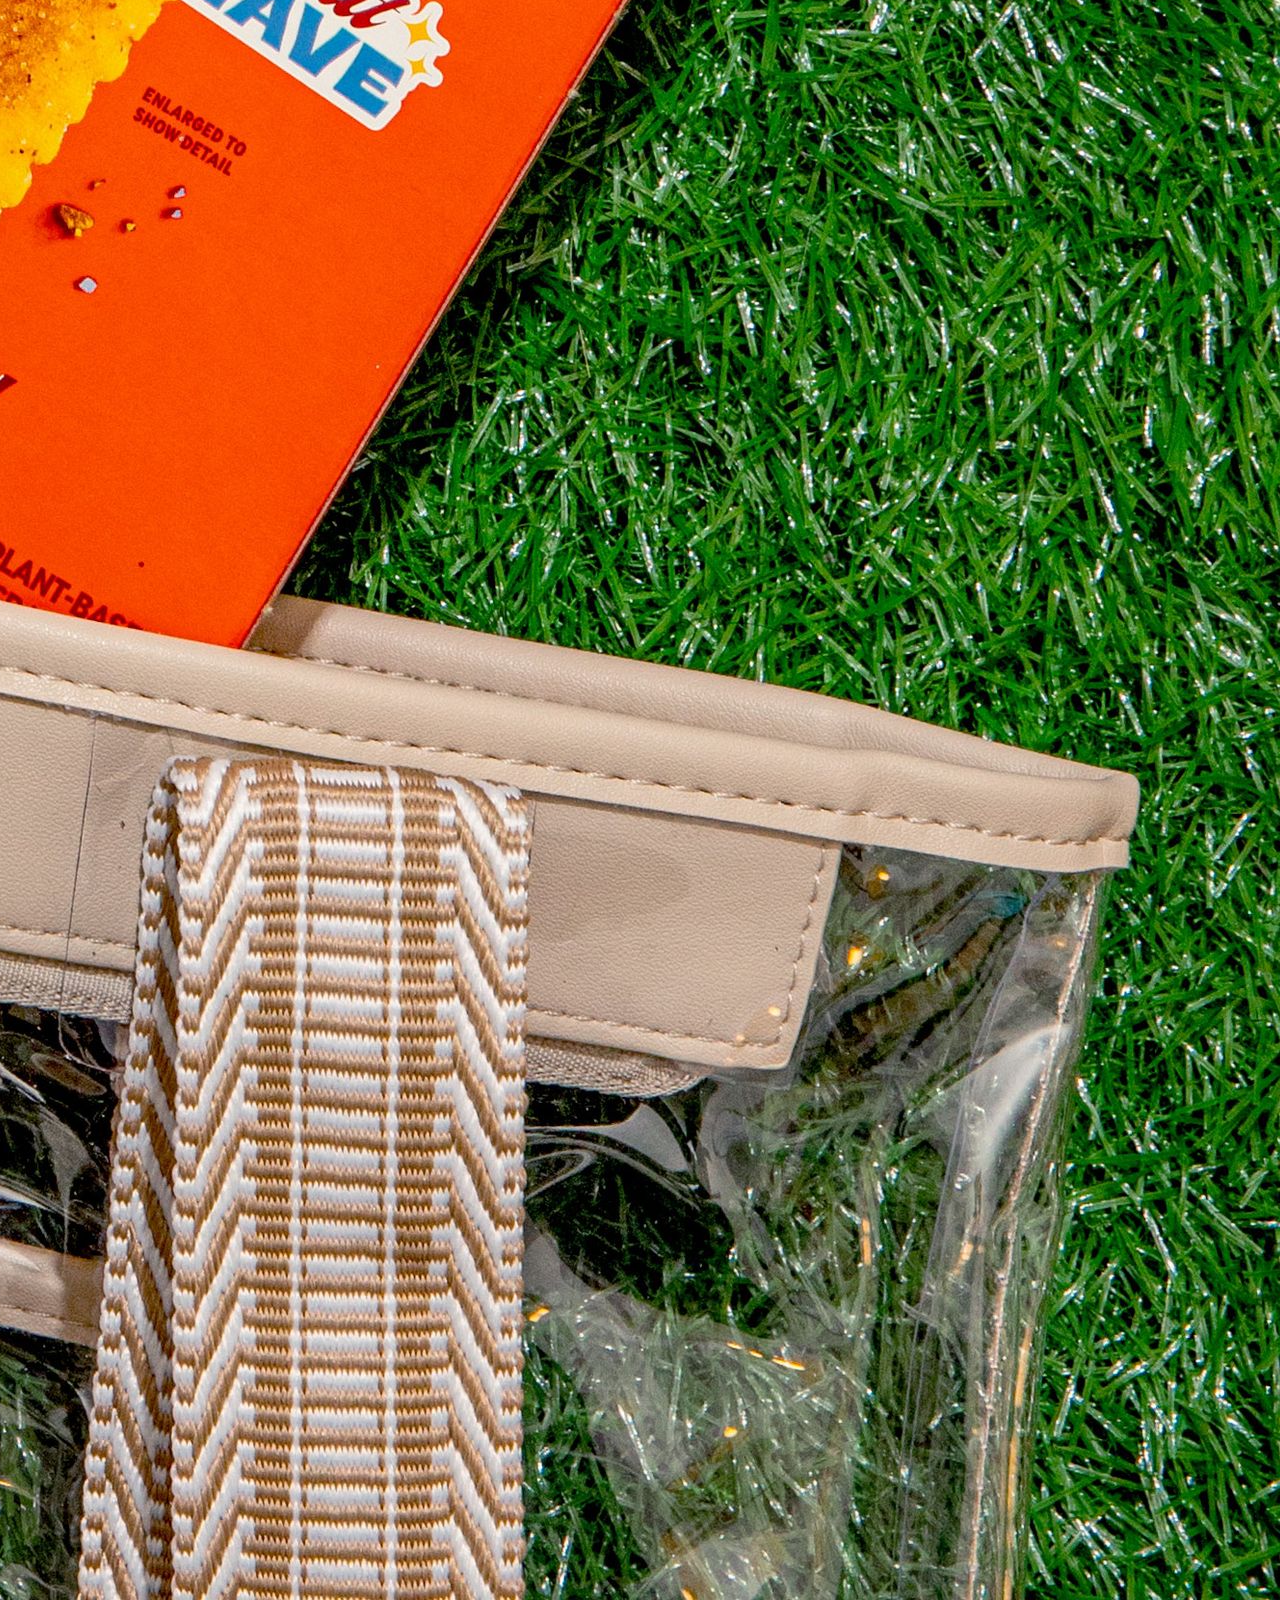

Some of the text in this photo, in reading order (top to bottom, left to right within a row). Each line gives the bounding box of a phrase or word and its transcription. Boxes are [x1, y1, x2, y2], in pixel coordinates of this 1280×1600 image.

[132, 106, 234, 178] SHOW DETAIL
[141, 86, 248, 158] ENLARGED TO
